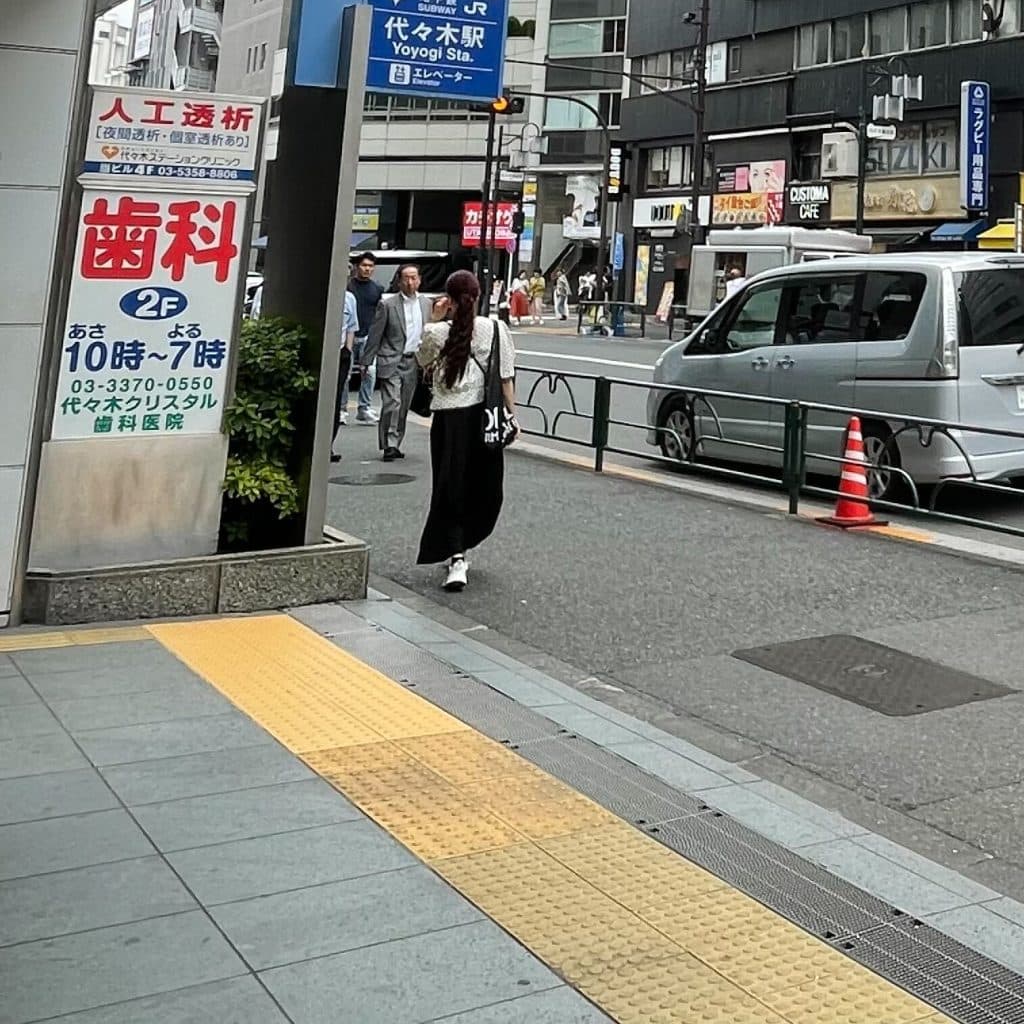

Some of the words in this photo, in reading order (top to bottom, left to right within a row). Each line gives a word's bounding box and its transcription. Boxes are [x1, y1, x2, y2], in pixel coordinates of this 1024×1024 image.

[418, 3, 457, 15] SUBWAY
[463, 1, 488, 16] JR
[384, 16, 485, 49] 代々木駅
[392, 41, 443, 62] Yoyogi
[446, 47, 475, 62] Sta.
[413, 68, 473, 83] エレベーター
[99, 97, 254, 132] 人工透析
[120, 150, 241, 167] 代々木ステーションクリニック
[790, 185, 830, 202] CUSTOMA
[800, 203, 819, 219] CAFE
[80, 196, 238, 283] 歯科
[135, 287, 180, 317] 2F
[68, 323, 107, 339] あさ
[167, 323, 202, 339] よる
[71, 376, 214, 394] 03-3370-0550
[61, 393, 218, 416] 代々木クリスタル
[93, 413, 185, 434] 歯科医院
